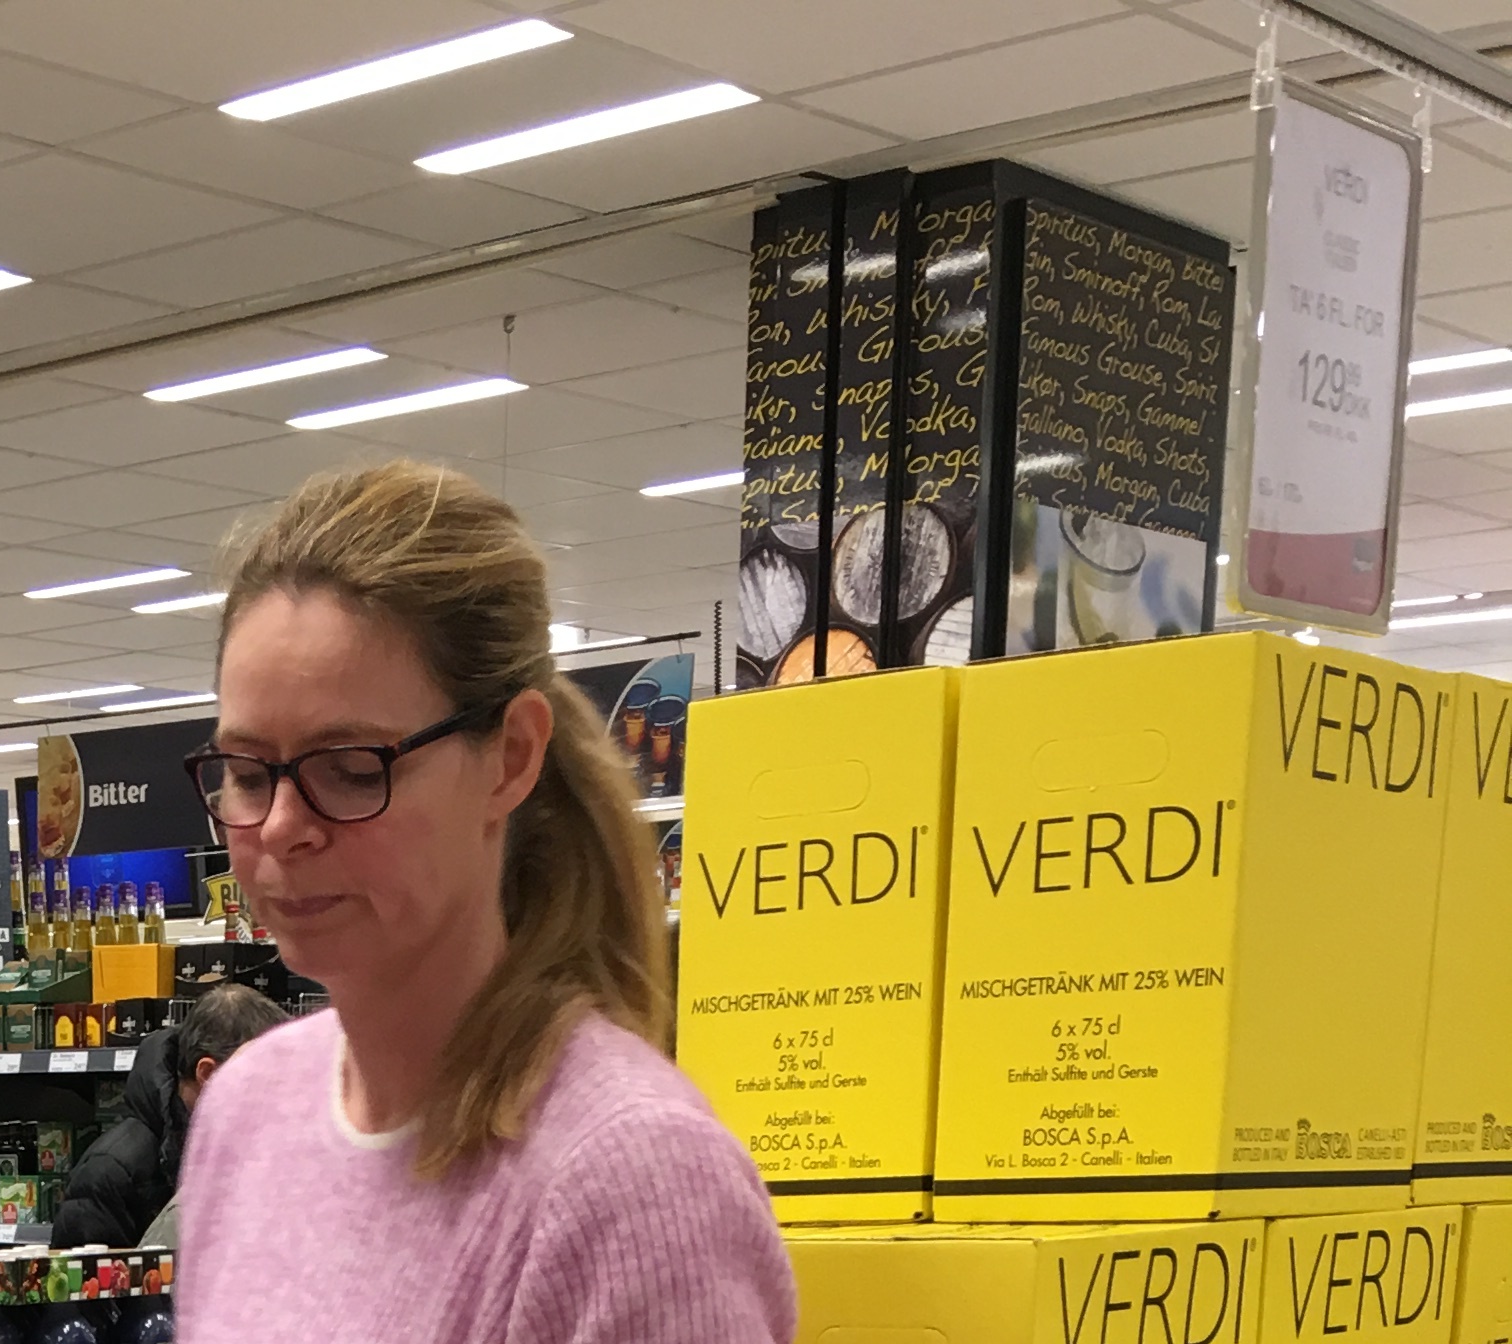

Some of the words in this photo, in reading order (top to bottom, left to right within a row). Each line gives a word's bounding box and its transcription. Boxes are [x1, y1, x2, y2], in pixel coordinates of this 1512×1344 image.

[1274, 653, 1441, 798] VERDI
[89, 782, 149, 808] Bitter
[971, 801, 1225, 898] VERDI
[698, 828, 919, 919] VERDI
[960, 971, 1095, 1000] MISCHGETRÄNK
[1098, 972, 1128, 992] MIT
[1134, 969, 1170, 990] 25%
[1175, 967, 1225, 987] WEIN
[1051, 1020, 1061, 1037] 6
[1067, 1024, 1077, 1036] x
[1081, 1017, 1103, 1036] 75
[1108, 1014, 1121, 1035] cl
[1055, 1043, 1080, 1061] 5%
[1084, 1039, 1111, 1060] vol.
[1008, 1066, 1048, 1083] Enthält
[1051, 1065, 1088, 1081] Sulfite
[1092, 1063, 1114, 1079] und
[1118, 1063, 1158, 1079] Gerste
[1040, 1103, 1094, 1123] Abgefüllt
[1097, 1102, 1120, 1118] bei:
[1023, 1128, 1080, 1146] BOSCA
[1022, 1153, 1056, 1167] Bosca
[1081, 1151, 1123, 1166] Canelli
[1136, 1149, 1172, 1165] Italien
[1288, 1226, 1450, 1339] VERDI
